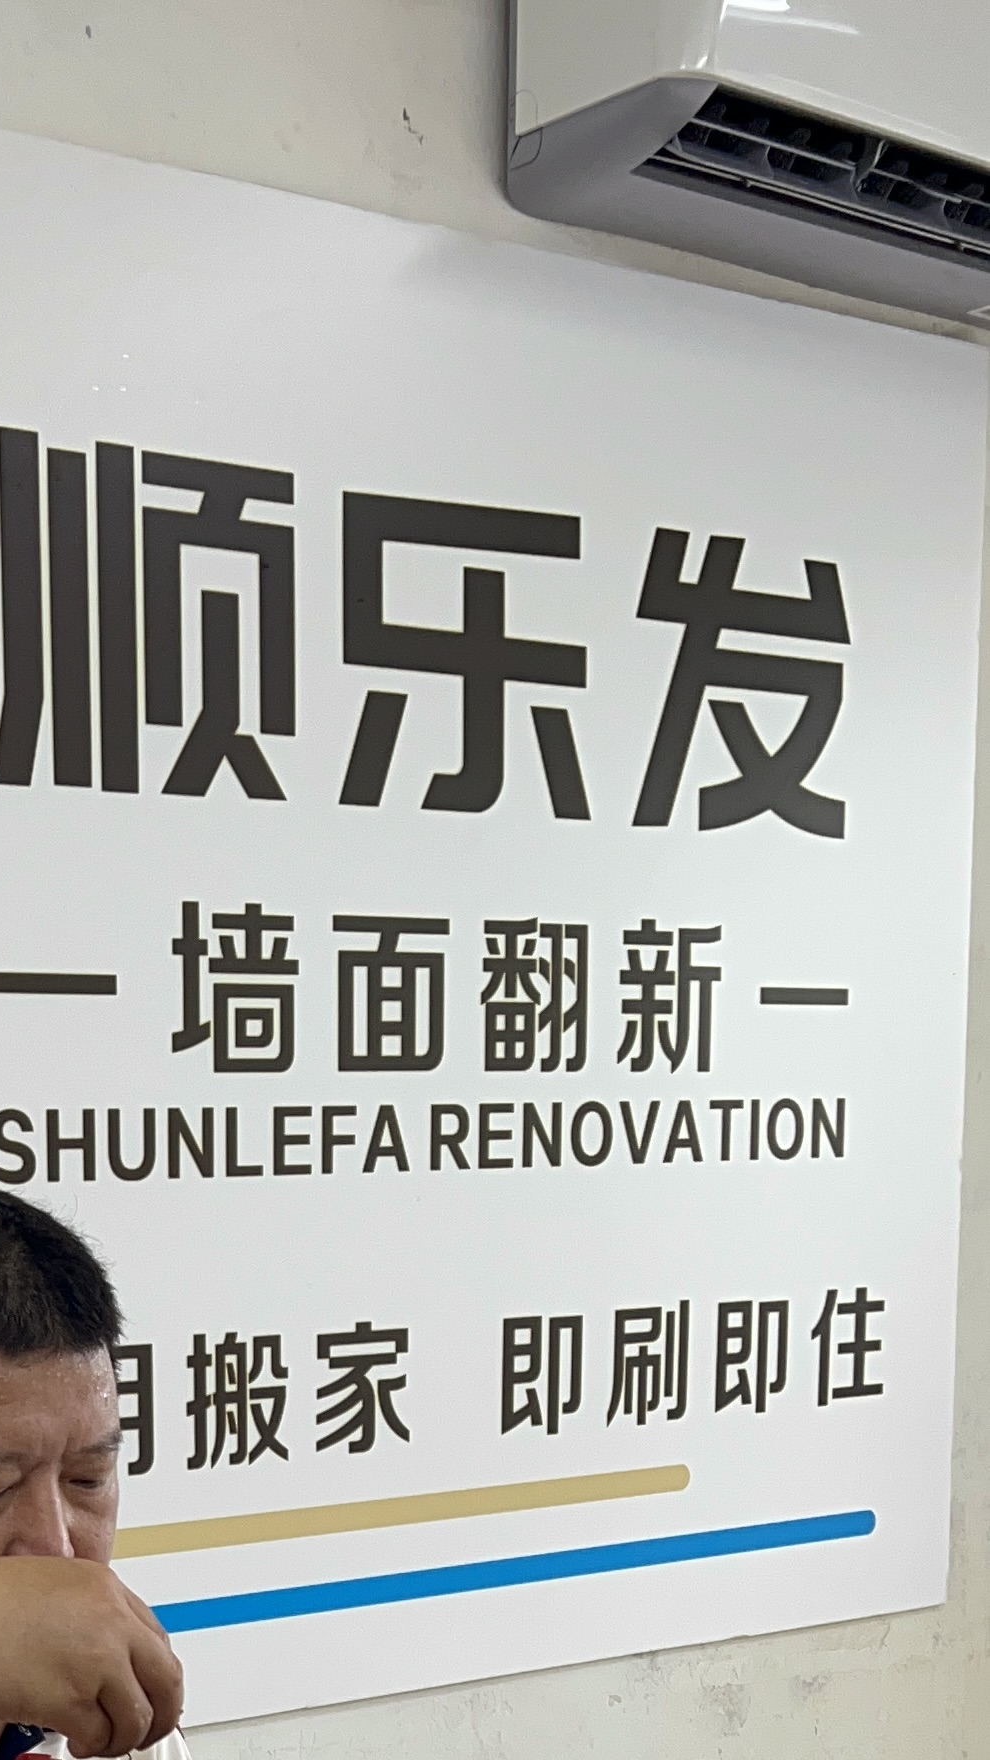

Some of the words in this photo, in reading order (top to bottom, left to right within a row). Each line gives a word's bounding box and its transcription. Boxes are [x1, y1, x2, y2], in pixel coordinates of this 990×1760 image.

[172, 901, 722, 1074] 墙面翻新
[431, 1098, 848, 1171] RENOVATION
[501, 1287, 885, 1436] 即刷即住
